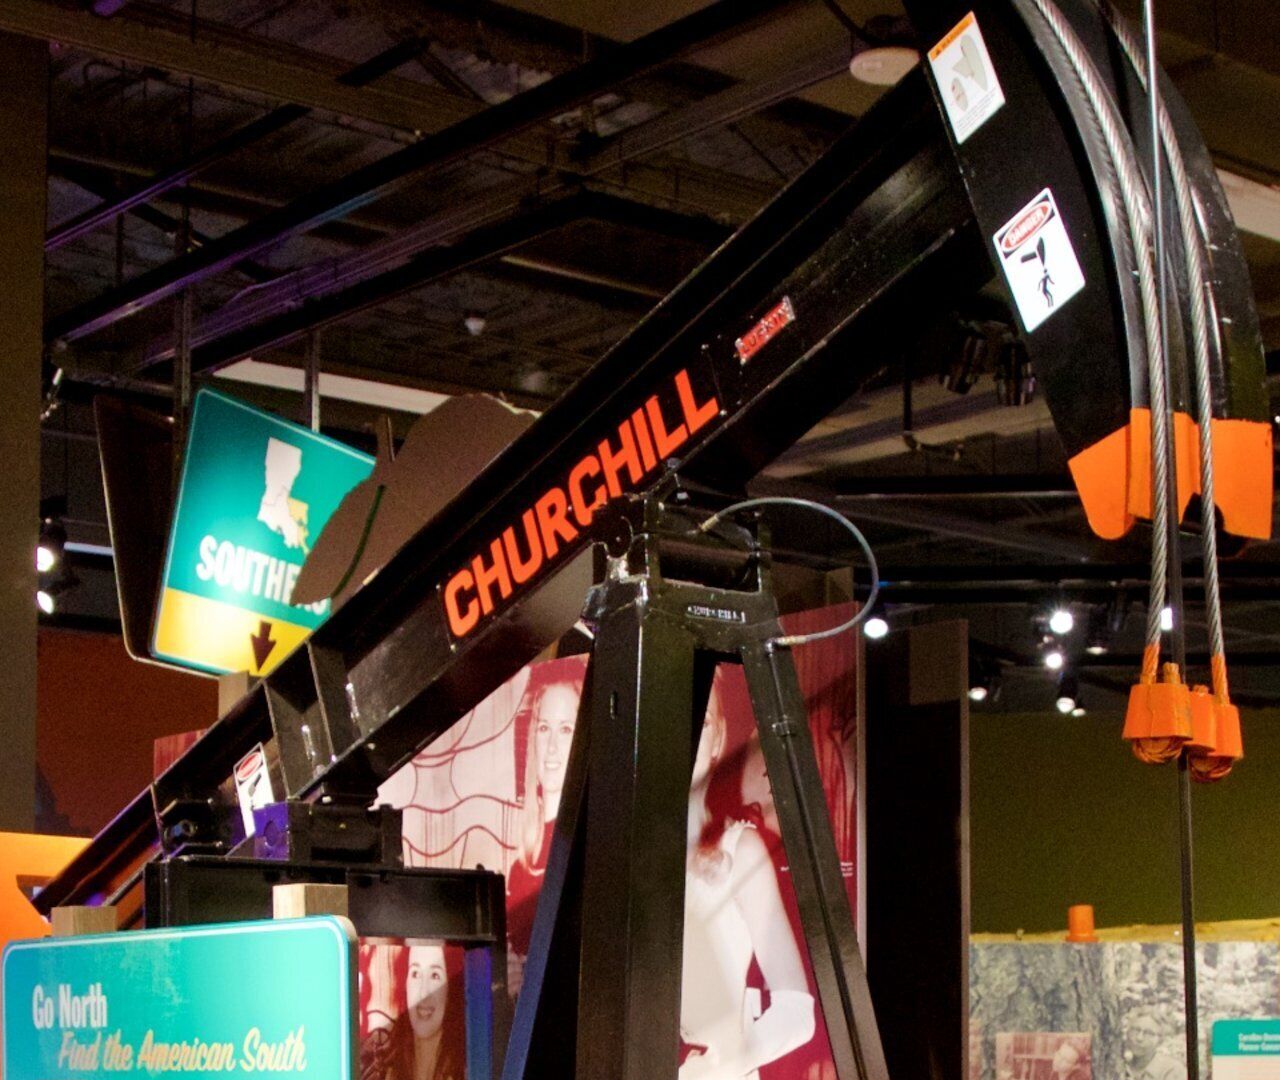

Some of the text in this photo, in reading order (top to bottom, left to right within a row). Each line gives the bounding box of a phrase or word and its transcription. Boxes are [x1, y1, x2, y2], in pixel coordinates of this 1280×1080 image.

[444, 369, 720, 638] CHURCHILL
[195, 534, 332, 616] SOUTHE
[33, 982, 107, 1028] Go North
[58, 1027, 307, 1072] Find the American South
